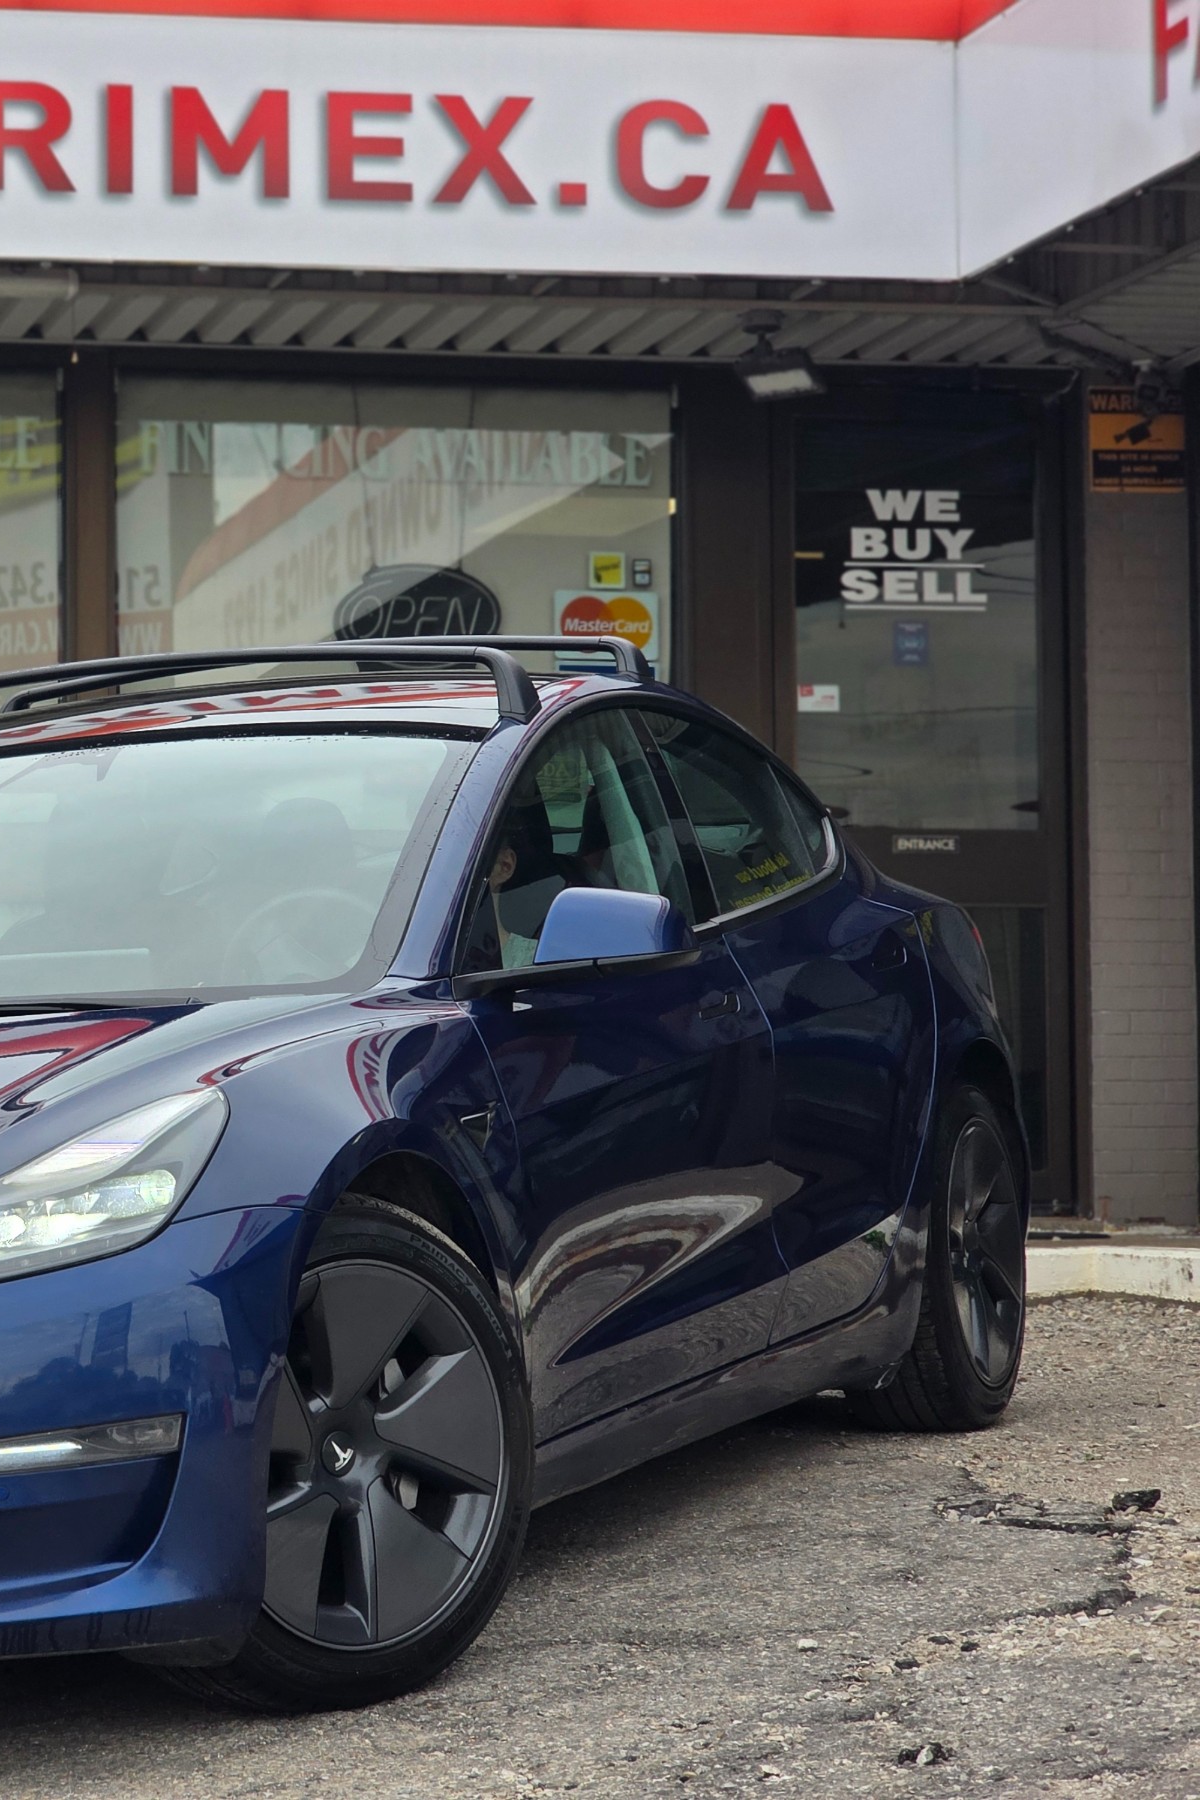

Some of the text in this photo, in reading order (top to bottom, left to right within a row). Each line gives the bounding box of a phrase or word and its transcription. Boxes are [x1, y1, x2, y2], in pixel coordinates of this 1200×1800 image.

[140, 421, 653, 487] FINNCING AVAILABLE
[865, 489, 961, 523] WE
[850, 527, 975, 561] BUY
[840, 569, 989, 604] SELL
[564, 618, 651, 634] MasterCard
[896, 838, 956, 851] ENTRANCE
[408, 1233, 474, 1289] PRIMACY
